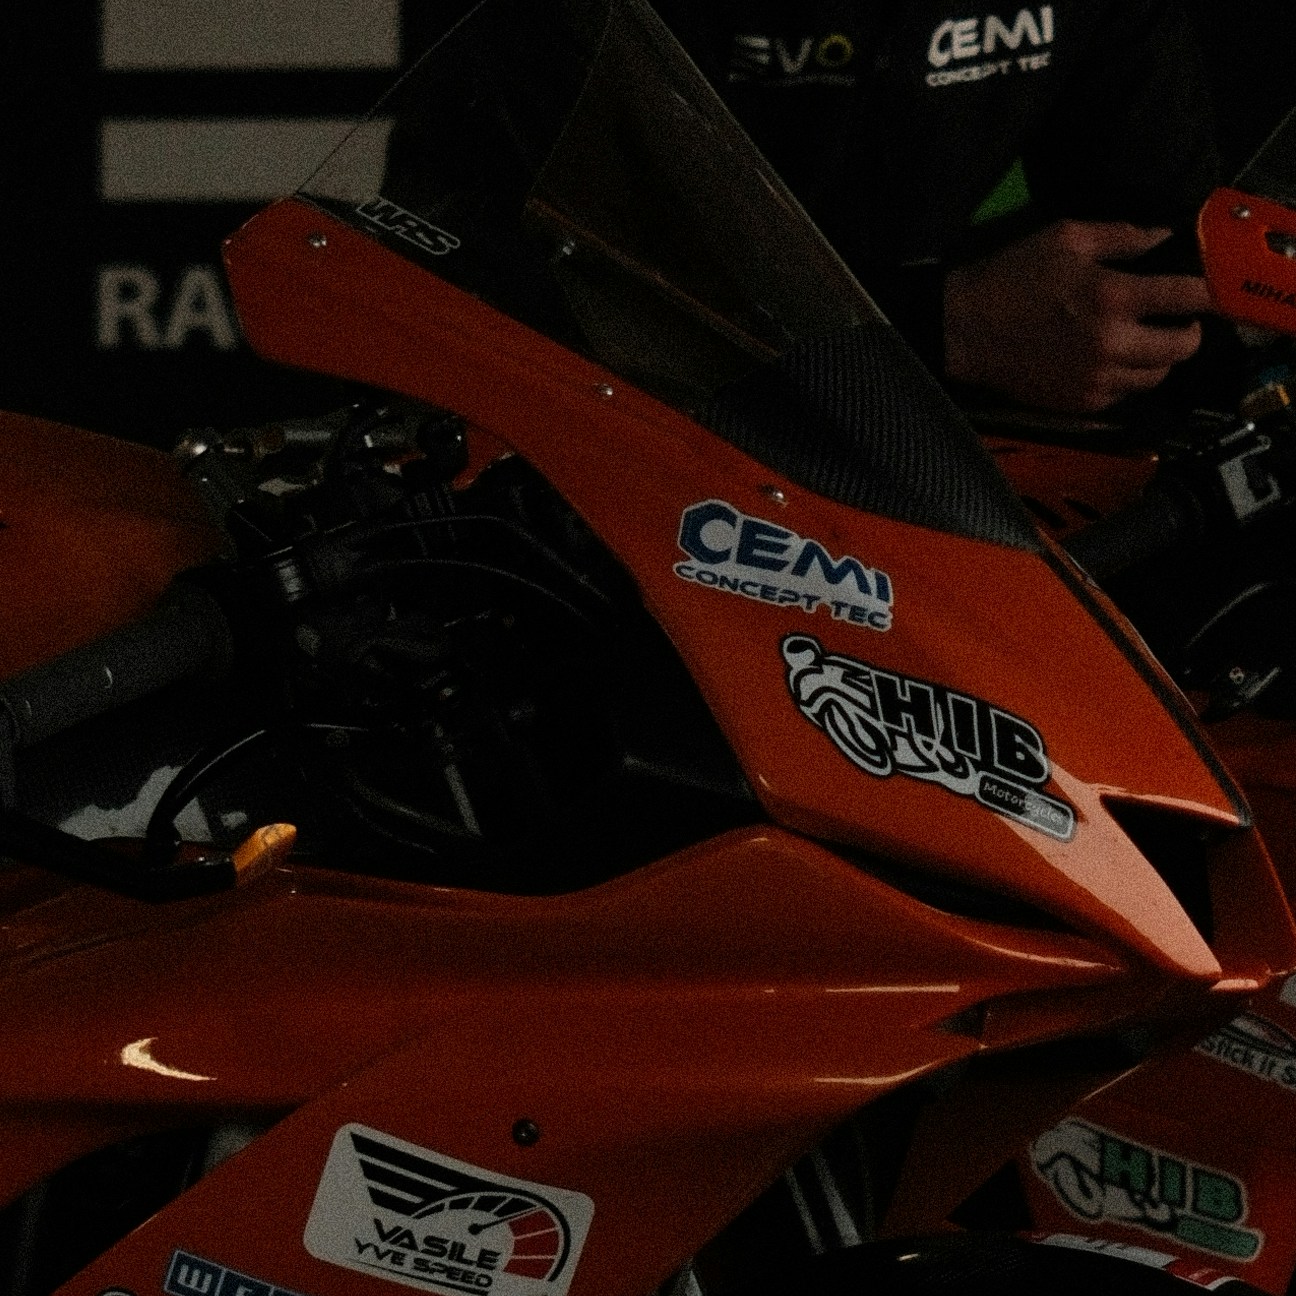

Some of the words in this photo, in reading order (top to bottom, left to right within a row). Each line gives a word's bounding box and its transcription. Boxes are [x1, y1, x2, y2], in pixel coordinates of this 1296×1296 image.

[926, 3, 1055, 68] CEMI
[680, 502, 891, 604] CEMI
[675, 564, 822, 611] CONCEPT
[830, 600, 890, 630] TEC
[869, 670, 1051, 785] HIB
[1100, 1134, 1243, 1222] HIB
[354, 1237, 406, 1267] YVE
[412, 1256, 494, 1289] SPEED
[373, 1218, 502, 1271] VASILE
